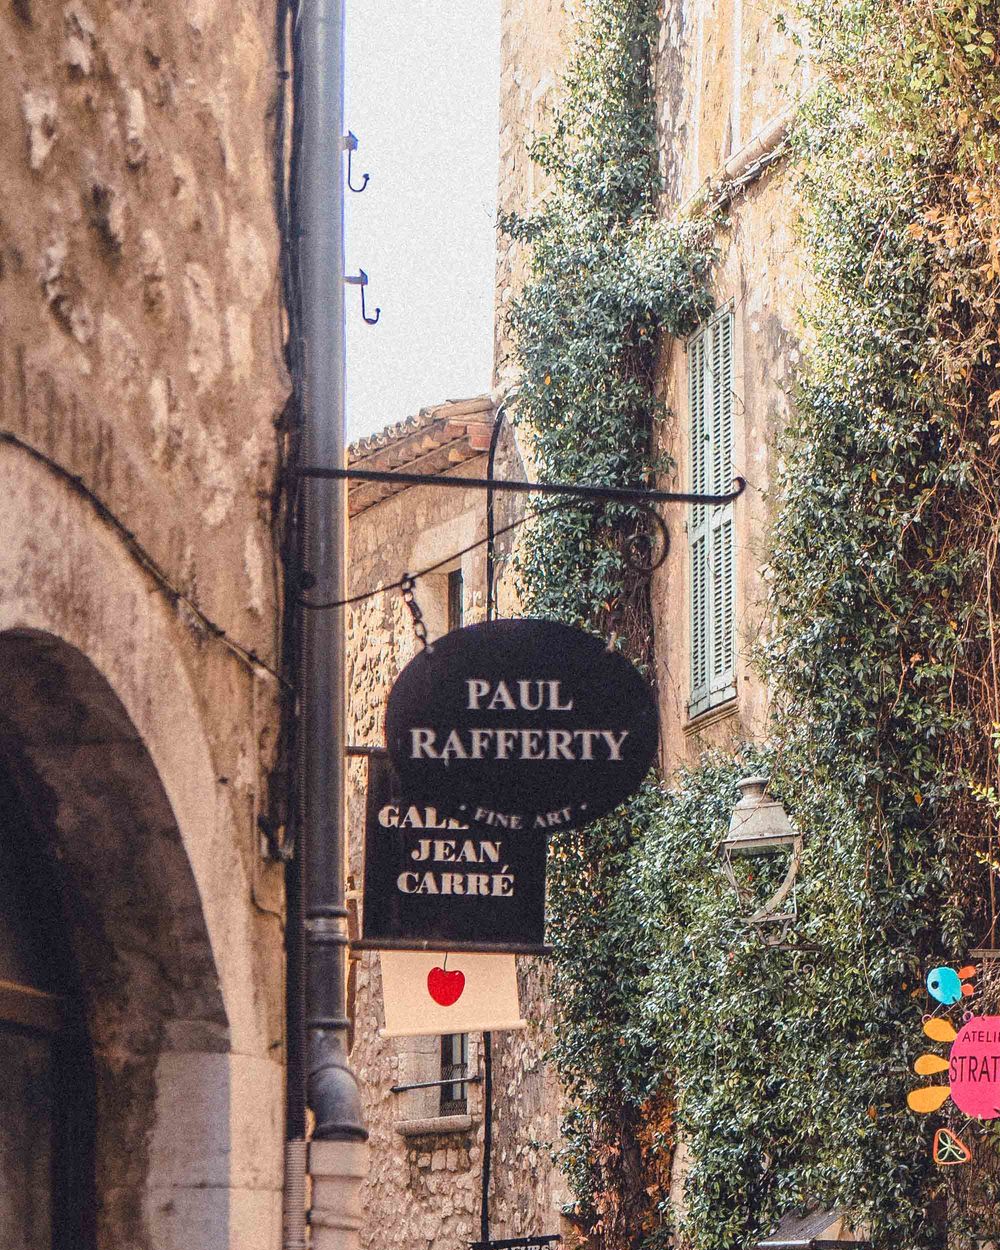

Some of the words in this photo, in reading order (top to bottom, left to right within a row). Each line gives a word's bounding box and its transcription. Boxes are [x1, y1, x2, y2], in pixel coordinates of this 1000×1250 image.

[465, 678, 574, 711] PAUL
[408, 728, 629, 761] RAFFERTY
[473, 806, 524, 830] FINE
[531, 807, 573, 829] ART
[411, 838, 502, 863] JEAN
[396, 864, 515, 897] CARRÉ
